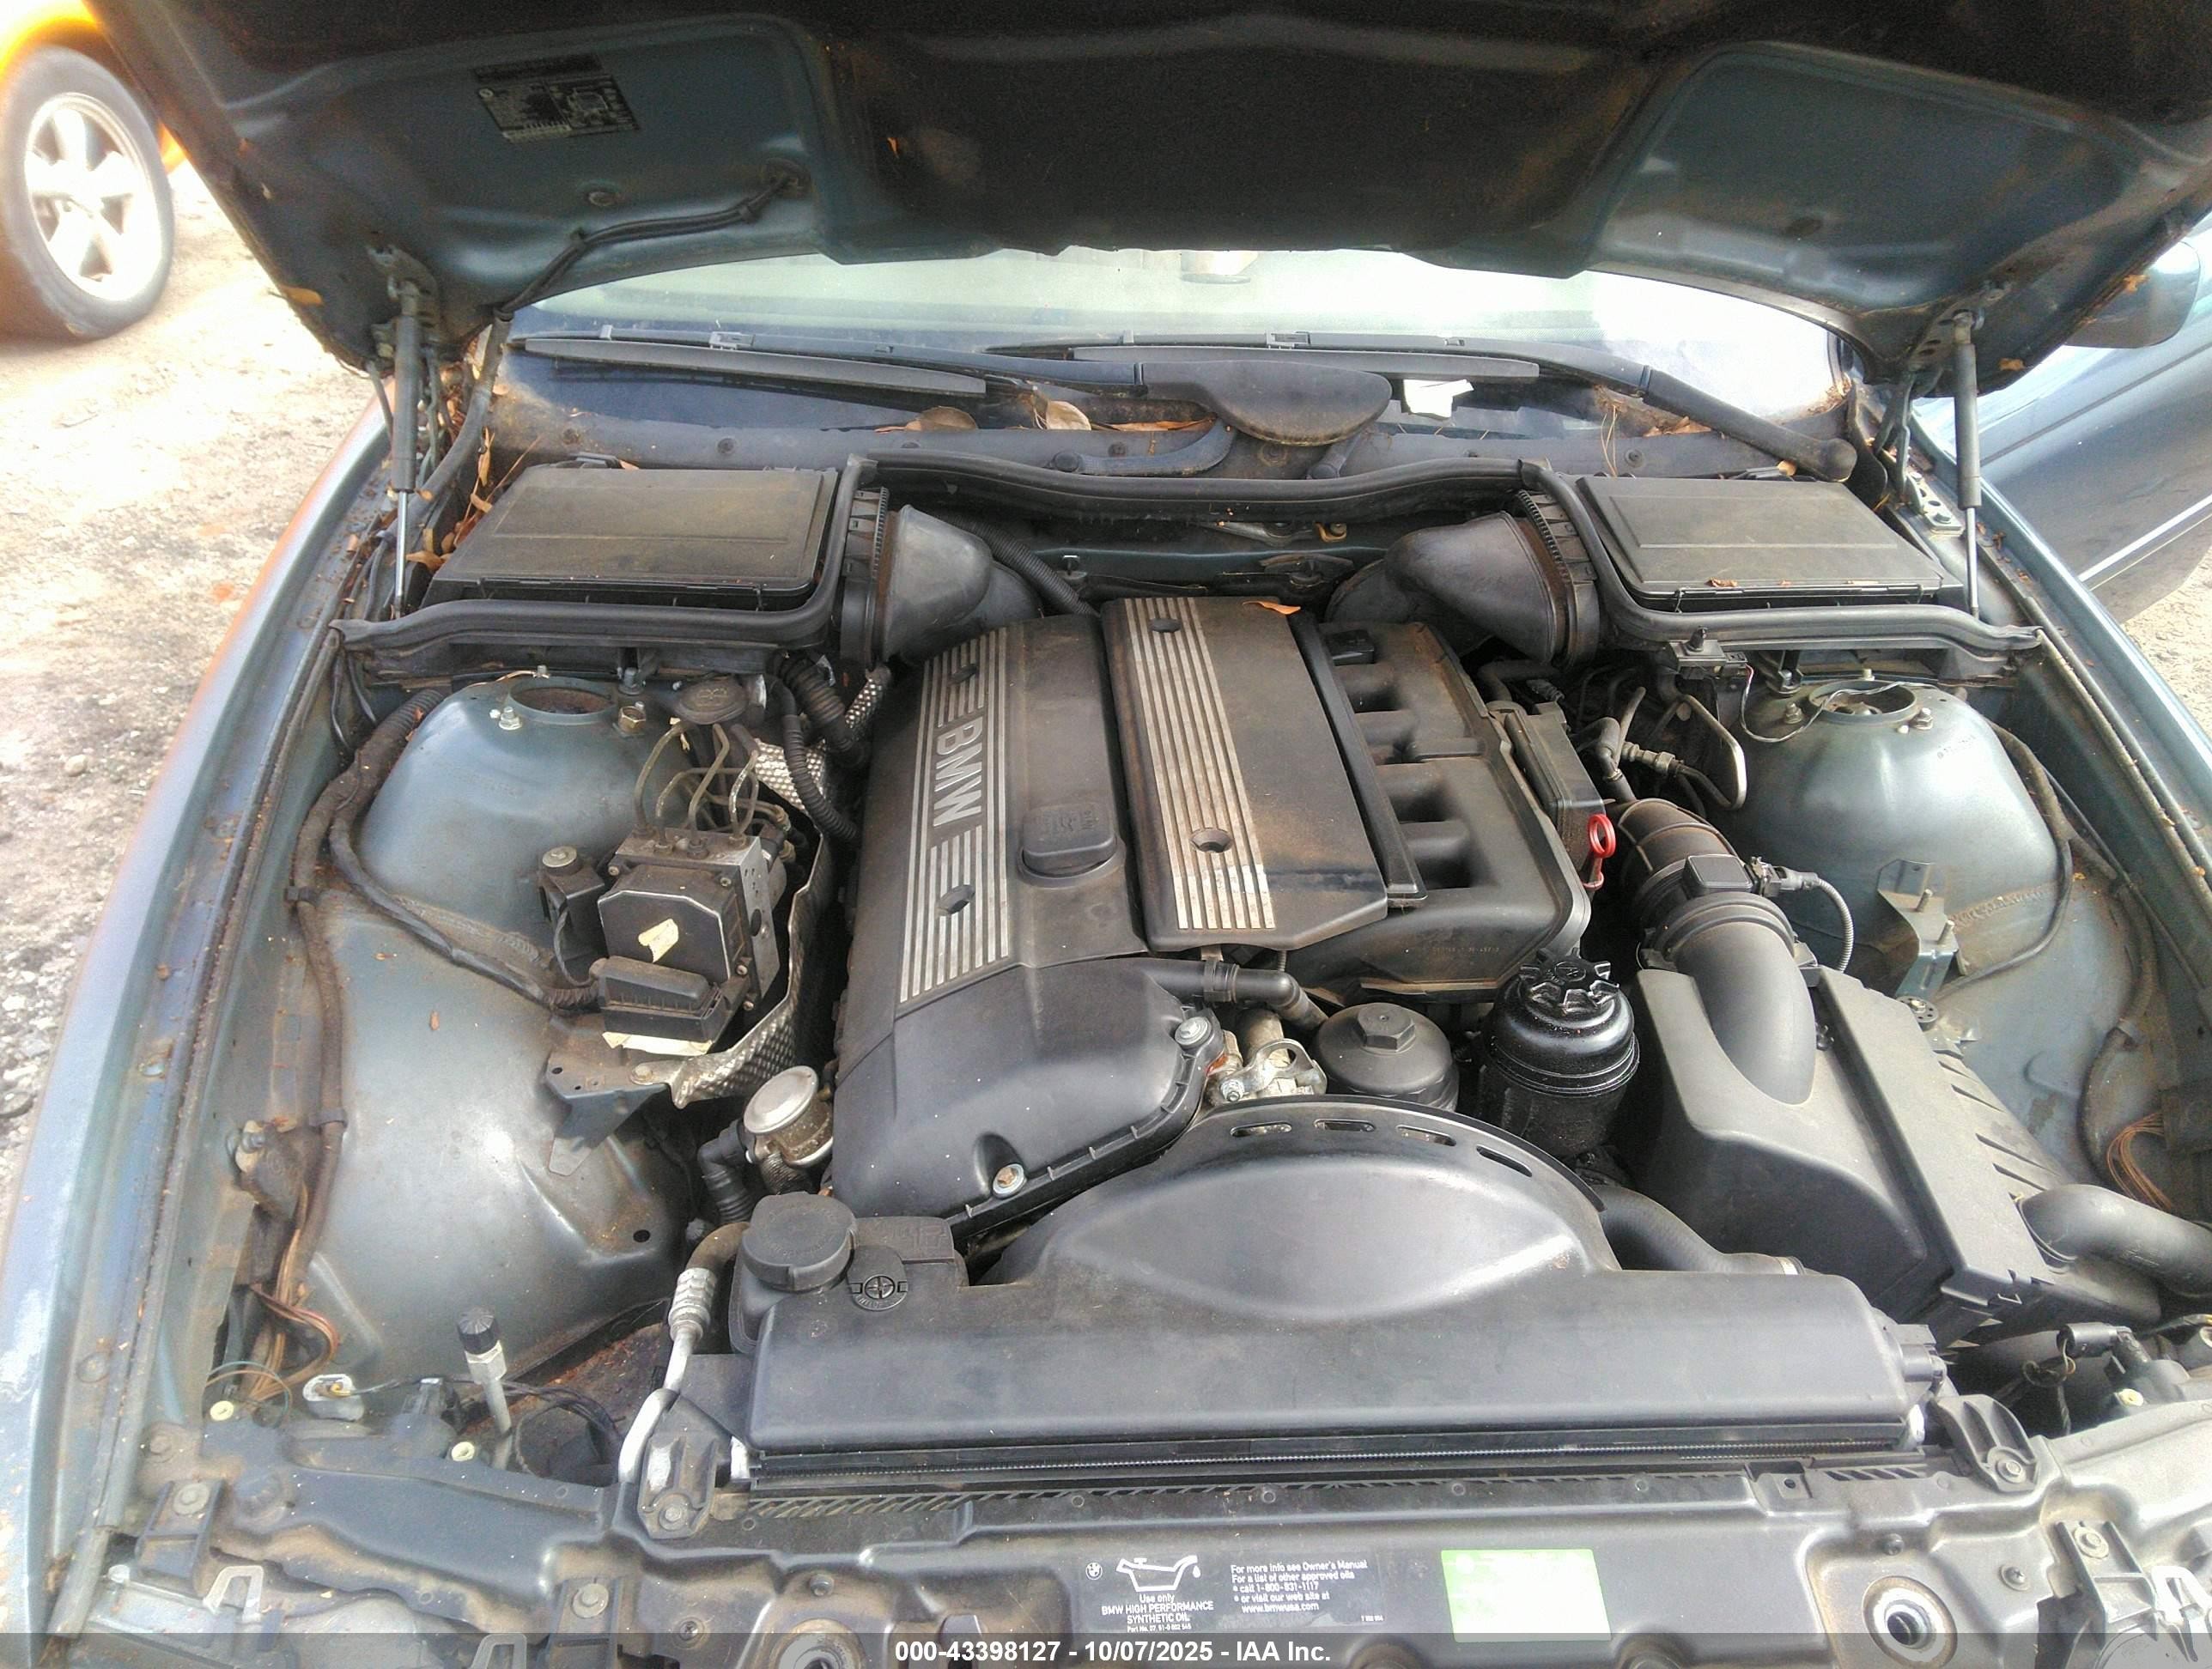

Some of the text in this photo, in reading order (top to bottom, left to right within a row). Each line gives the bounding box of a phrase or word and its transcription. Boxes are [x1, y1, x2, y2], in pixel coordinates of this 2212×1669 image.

[933, 716, 982, 826] BMW
[1231, 1564, 1245, 1573] For
[1269, 1563, 1285, 1572] info
[1303, 1561, 1336, 1571] Owner's
[1337, 1559, 1367, 1569] Manual
[1231, 1574, 1246, 1583] For
[1255, 1573, 1267, 1582] list
[1269, 1573, 1277, 1581] of
[1278, 1573, 1299, 1581] other
[1301, 1569, 1339, 1581] approved
[1340, 1569, 1355, 1579] oils
[1239, 1581, 1319, 1593] call 1-800-831-1117
[1139, 1593, 1175, 1603] Use only
[1251, 1593, 1268, 1602] visit
[1285, 1592, 1304, 1600] web
[1304, 1591, 1320, 1600] site
[1322, 1591, 1330, 1599] at
[1102, 1600, 1214, 1615] BMW HIGH PERFORMANCE
[1242, 1603, 1319, 1613] www.bmwusa.com
[1127, 1612, 1190, 1624] SYNTHETIC OIL
